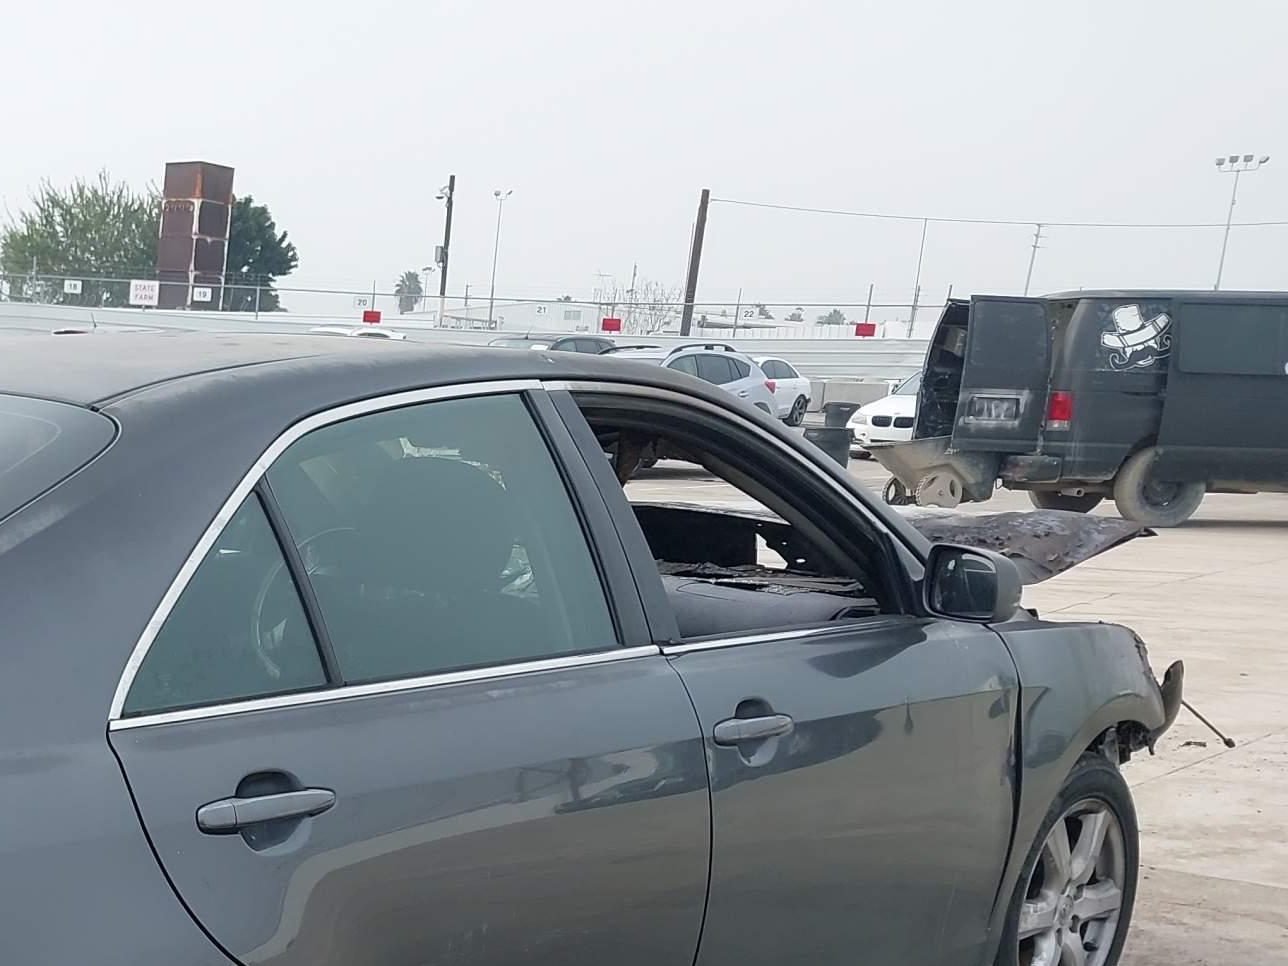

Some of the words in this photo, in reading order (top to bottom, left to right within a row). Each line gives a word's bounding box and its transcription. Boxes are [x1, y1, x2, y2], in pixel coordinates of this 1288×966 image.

[133, 284, 155, 292] STATE
[136, 293, 154, 301] FARM
[357, 298, 368, 307] 20
[537, 305, 547, 314] 21
[744, 310, 754, 318] 22
